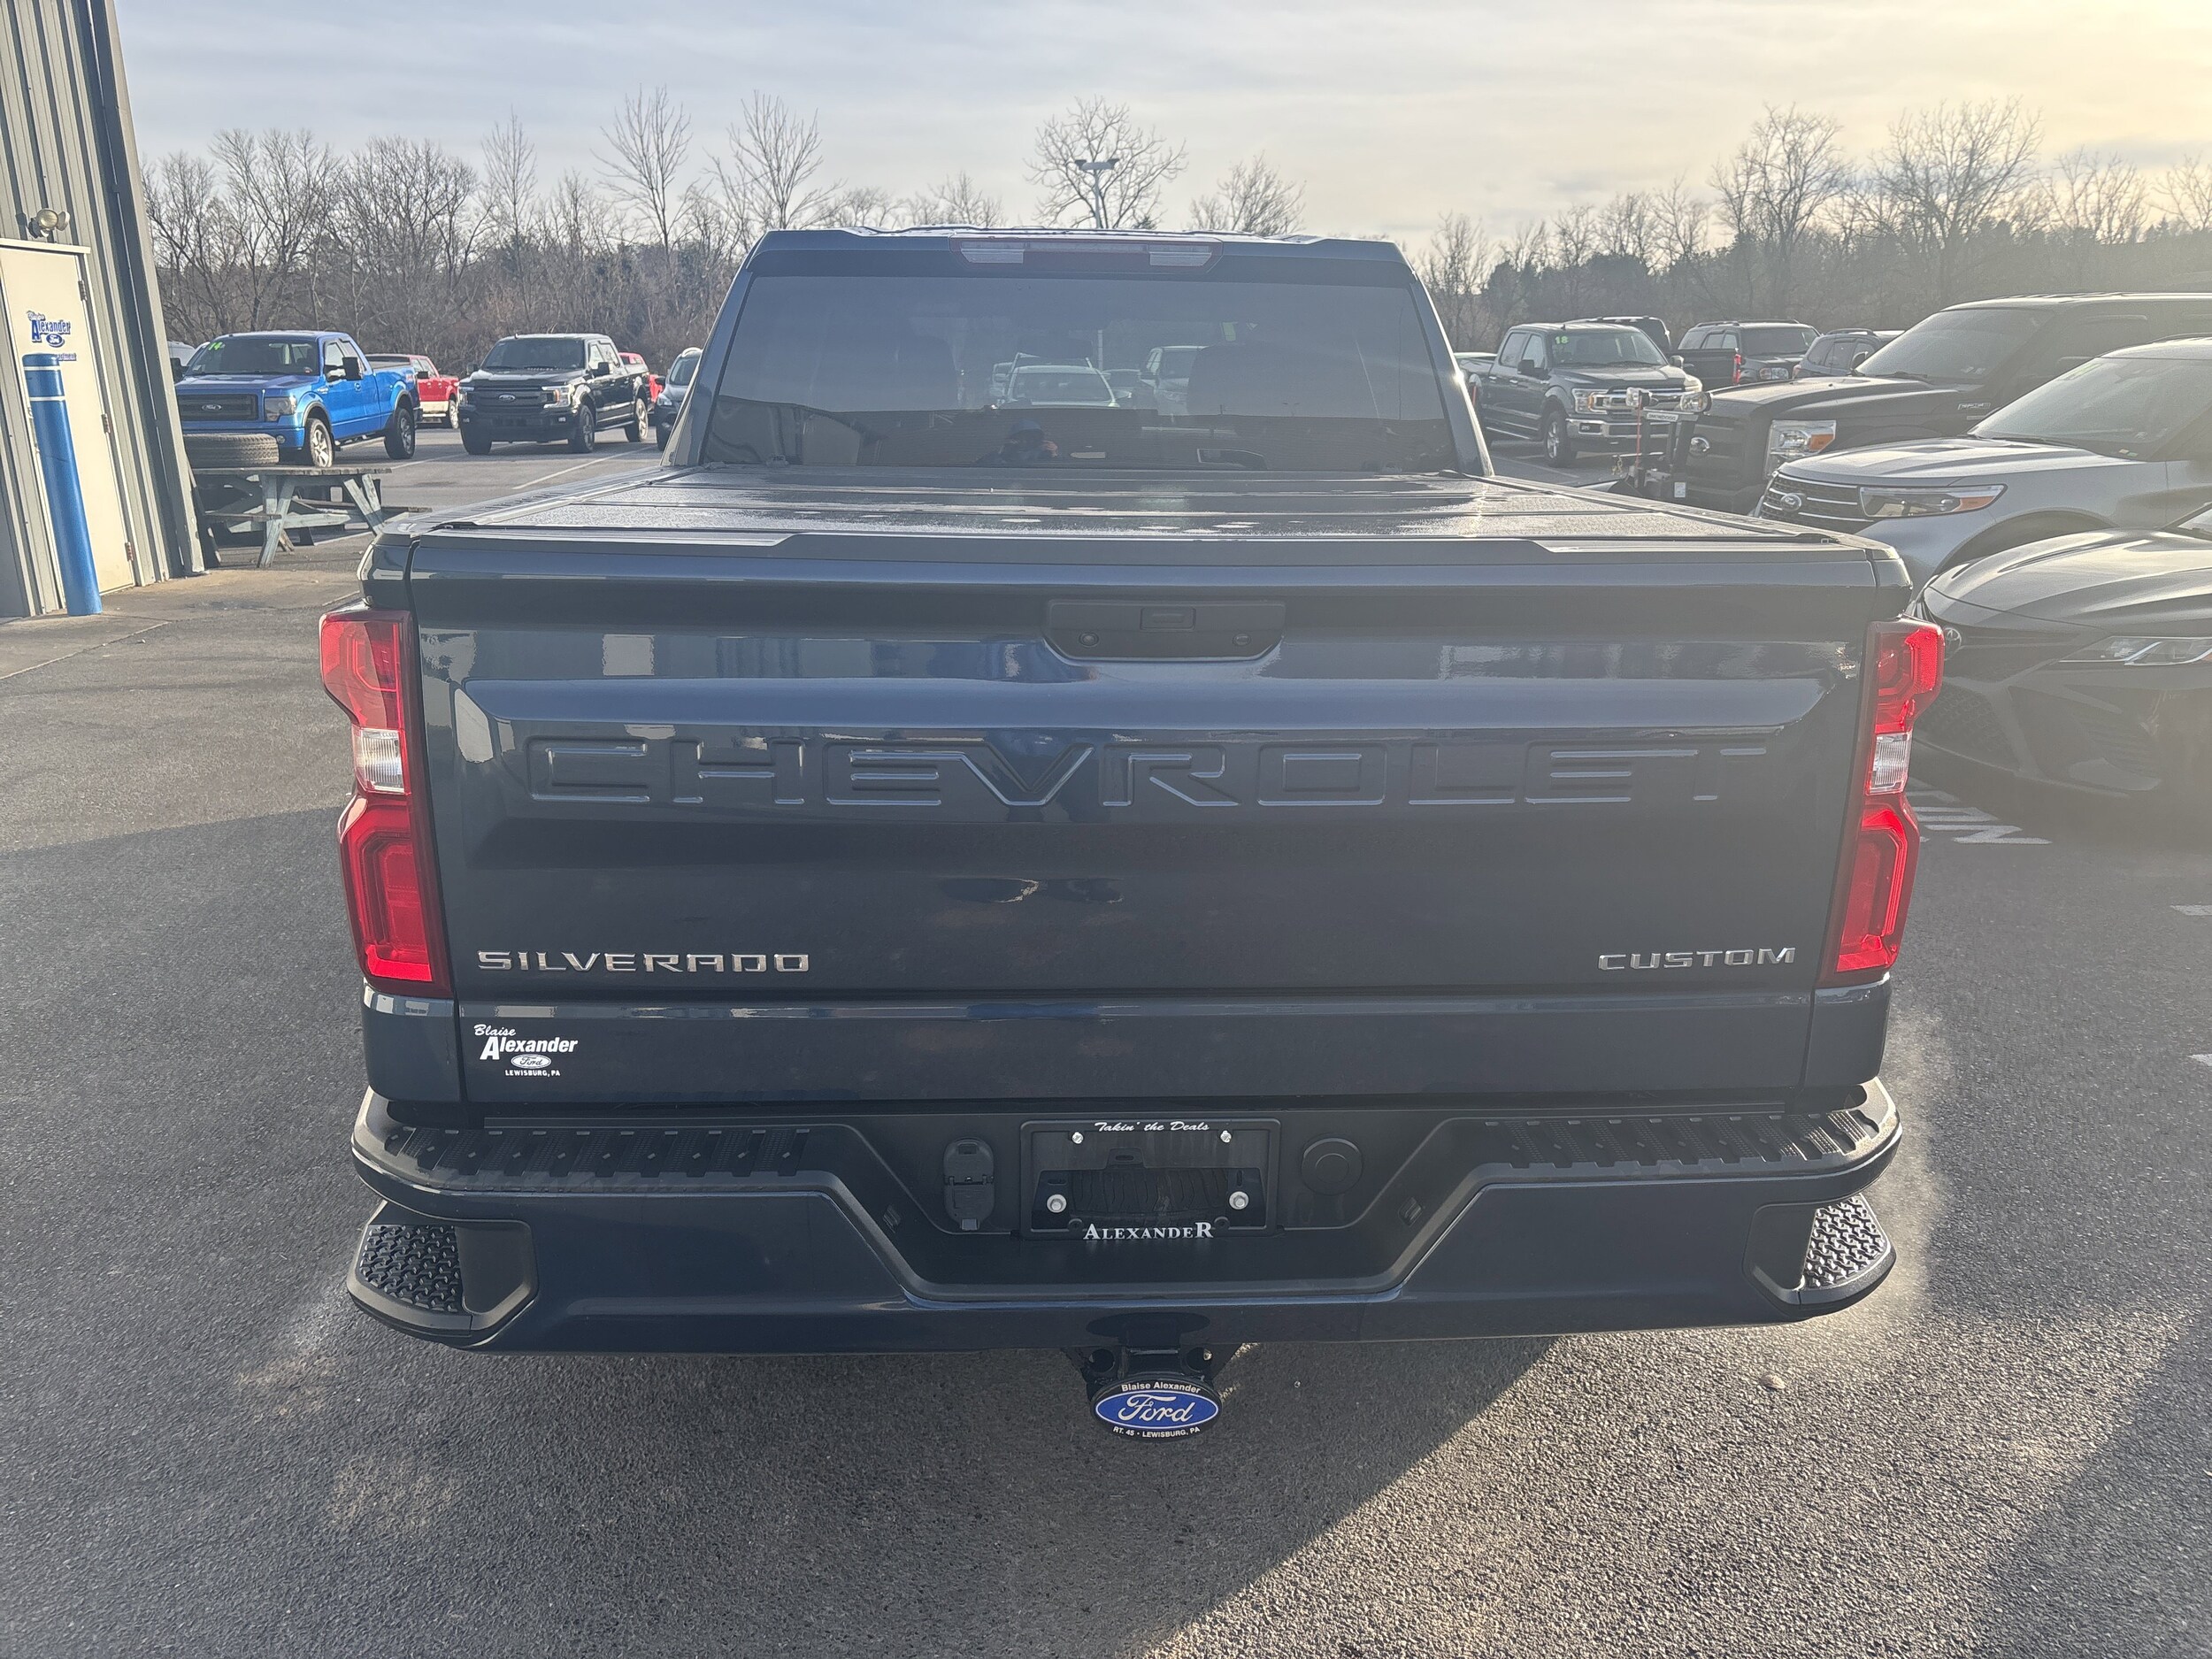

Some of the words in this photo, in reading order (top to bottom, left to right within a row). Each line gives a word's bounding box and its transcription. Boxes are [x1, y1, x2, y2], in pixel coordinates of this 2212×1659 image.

[31, 319, 71, 342] Alexander
[1555, 335, 1569, 344] 18
[526, 734, 1769, 808] CHEVROLET
[477, 949, 810, 972] SILVERADO
[1597, 947, 1796, 971] CUSTOM
[473, 1023, 517, 1037] Blaise
[479, 1036, 579, 1060] Alexander
[518, 1056, 544, 1066] Ford
[504, 1069, 550, 1078] LEWISBURG,
[1094, 1121, 1141, 1133] Takin'
[1144, 1121, 1165, 1132] the
[1170, 1120, 1210, 1132] Deals
[1082, 1222, 1214, 1240] ALEXANDER
[1121, 1382, 1151, 1393] Blaise
[1153, 1381, 1202, 1394] Alexander
[1118, 1394, 1196, 1422] Ford
[1112, 1425, 1125, 1434] RT.
[1141, 1428, 1189, 1439] LEWISBURG,
[1189, 1425, 1201, 1434] PA
